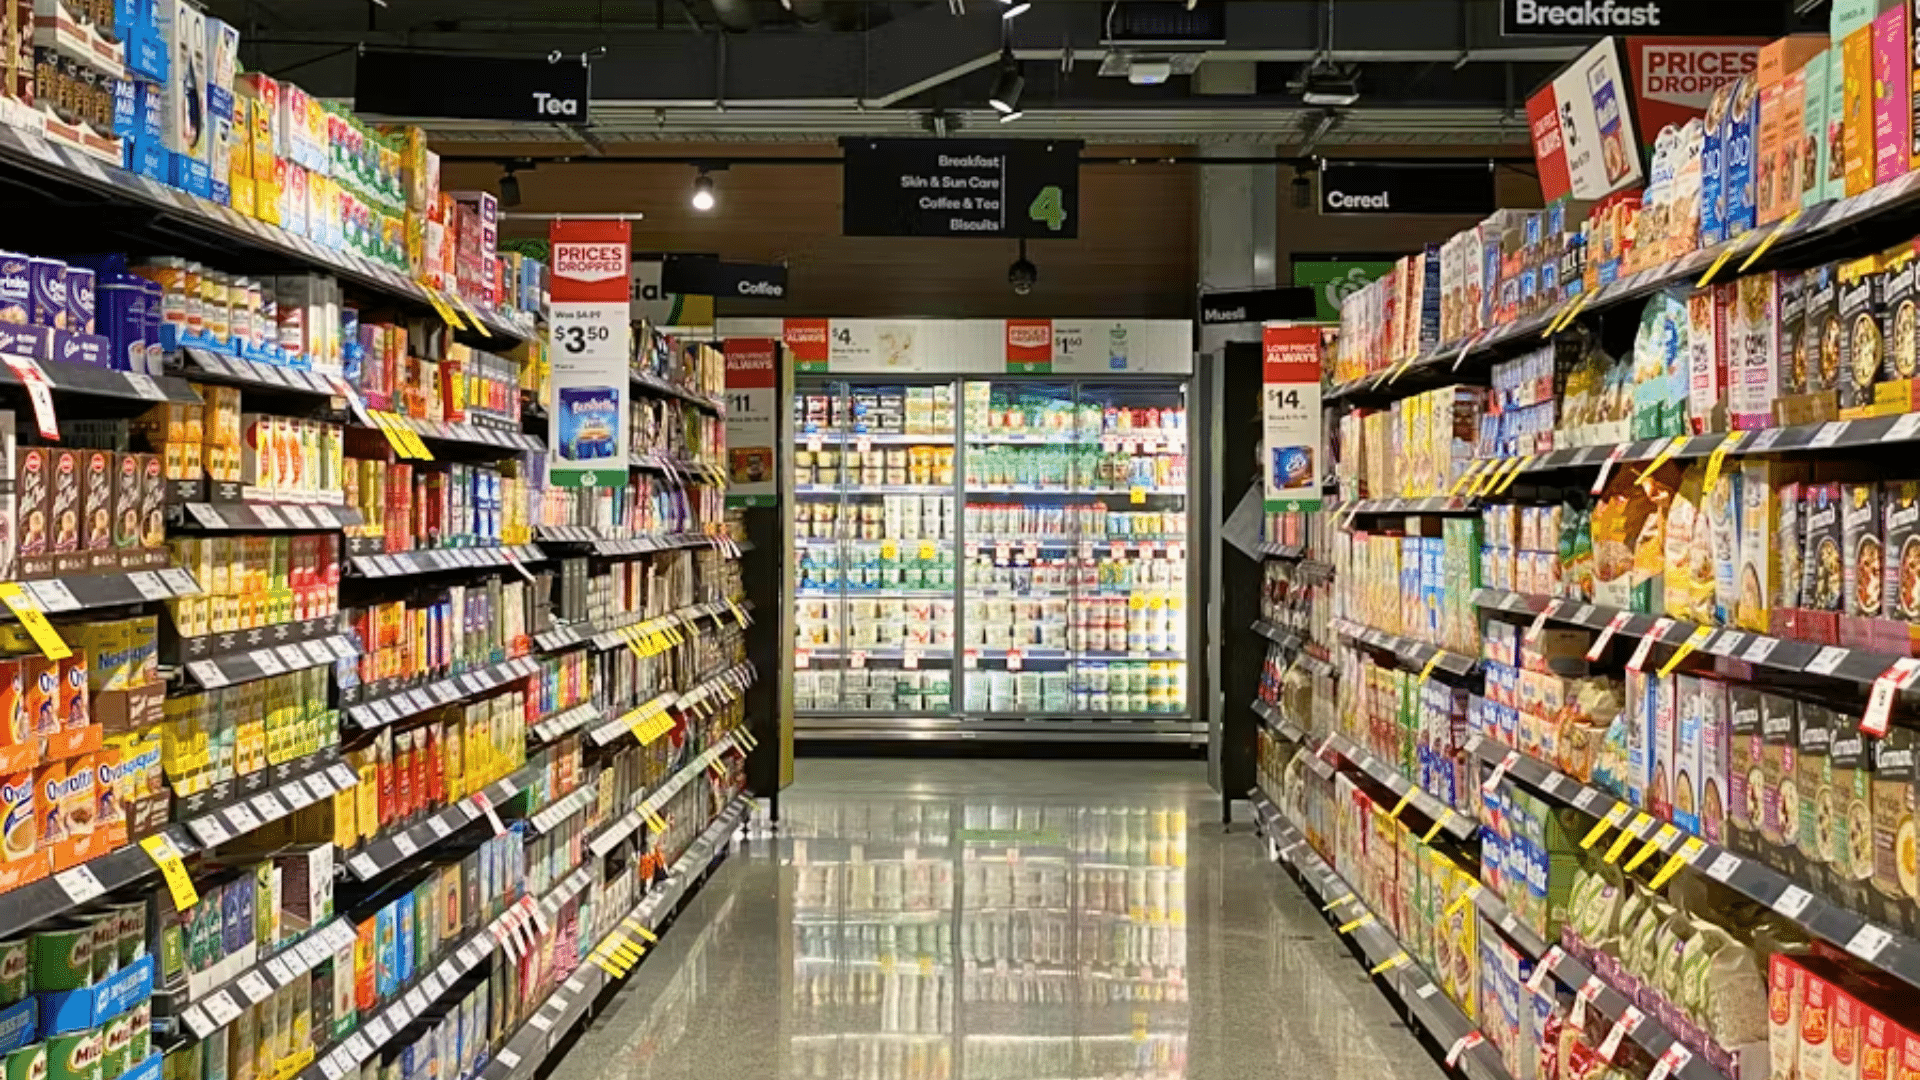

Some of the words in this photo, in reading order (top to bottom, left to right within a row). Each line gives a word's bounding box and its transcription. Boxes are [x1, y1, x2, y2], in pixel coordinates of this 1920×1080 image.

[1516, 0, 1660, 26] Breakfast
[1648, 52, 1758, 74] PRICES
[1648, 76, 1740, 93] DROPP
[533, 93, 577, 115] Tea
[938, 155, 999, 167] Breakfast
[901, 176, 928, 188] Skin
[930, 176, 940, 188] &
[942, 176, 967, 188] Sun
[968, 177, 999, 188] Care
[919, 197, 960, 209] Coffee
[962, 197, 973, 209] &
[975, 198, 999, 209] Tea
[1327, 190, 1390, 208] Cereal
[1029, 186, 1067, 230] 4
[950, 218, 999, 231] Biscuits
[558, 247, 622, 260] PRICES
[558, 261, 622, 272] DROPPED
[737, 280, 784, 296] Coffee
[1204, 306, 1247, 321] Muesli
[1267, 344, 1289, 352] LOW
[1291, 343, 1317, 352] PRICE
[1267, 353, 1317, 363] ALWAYS
